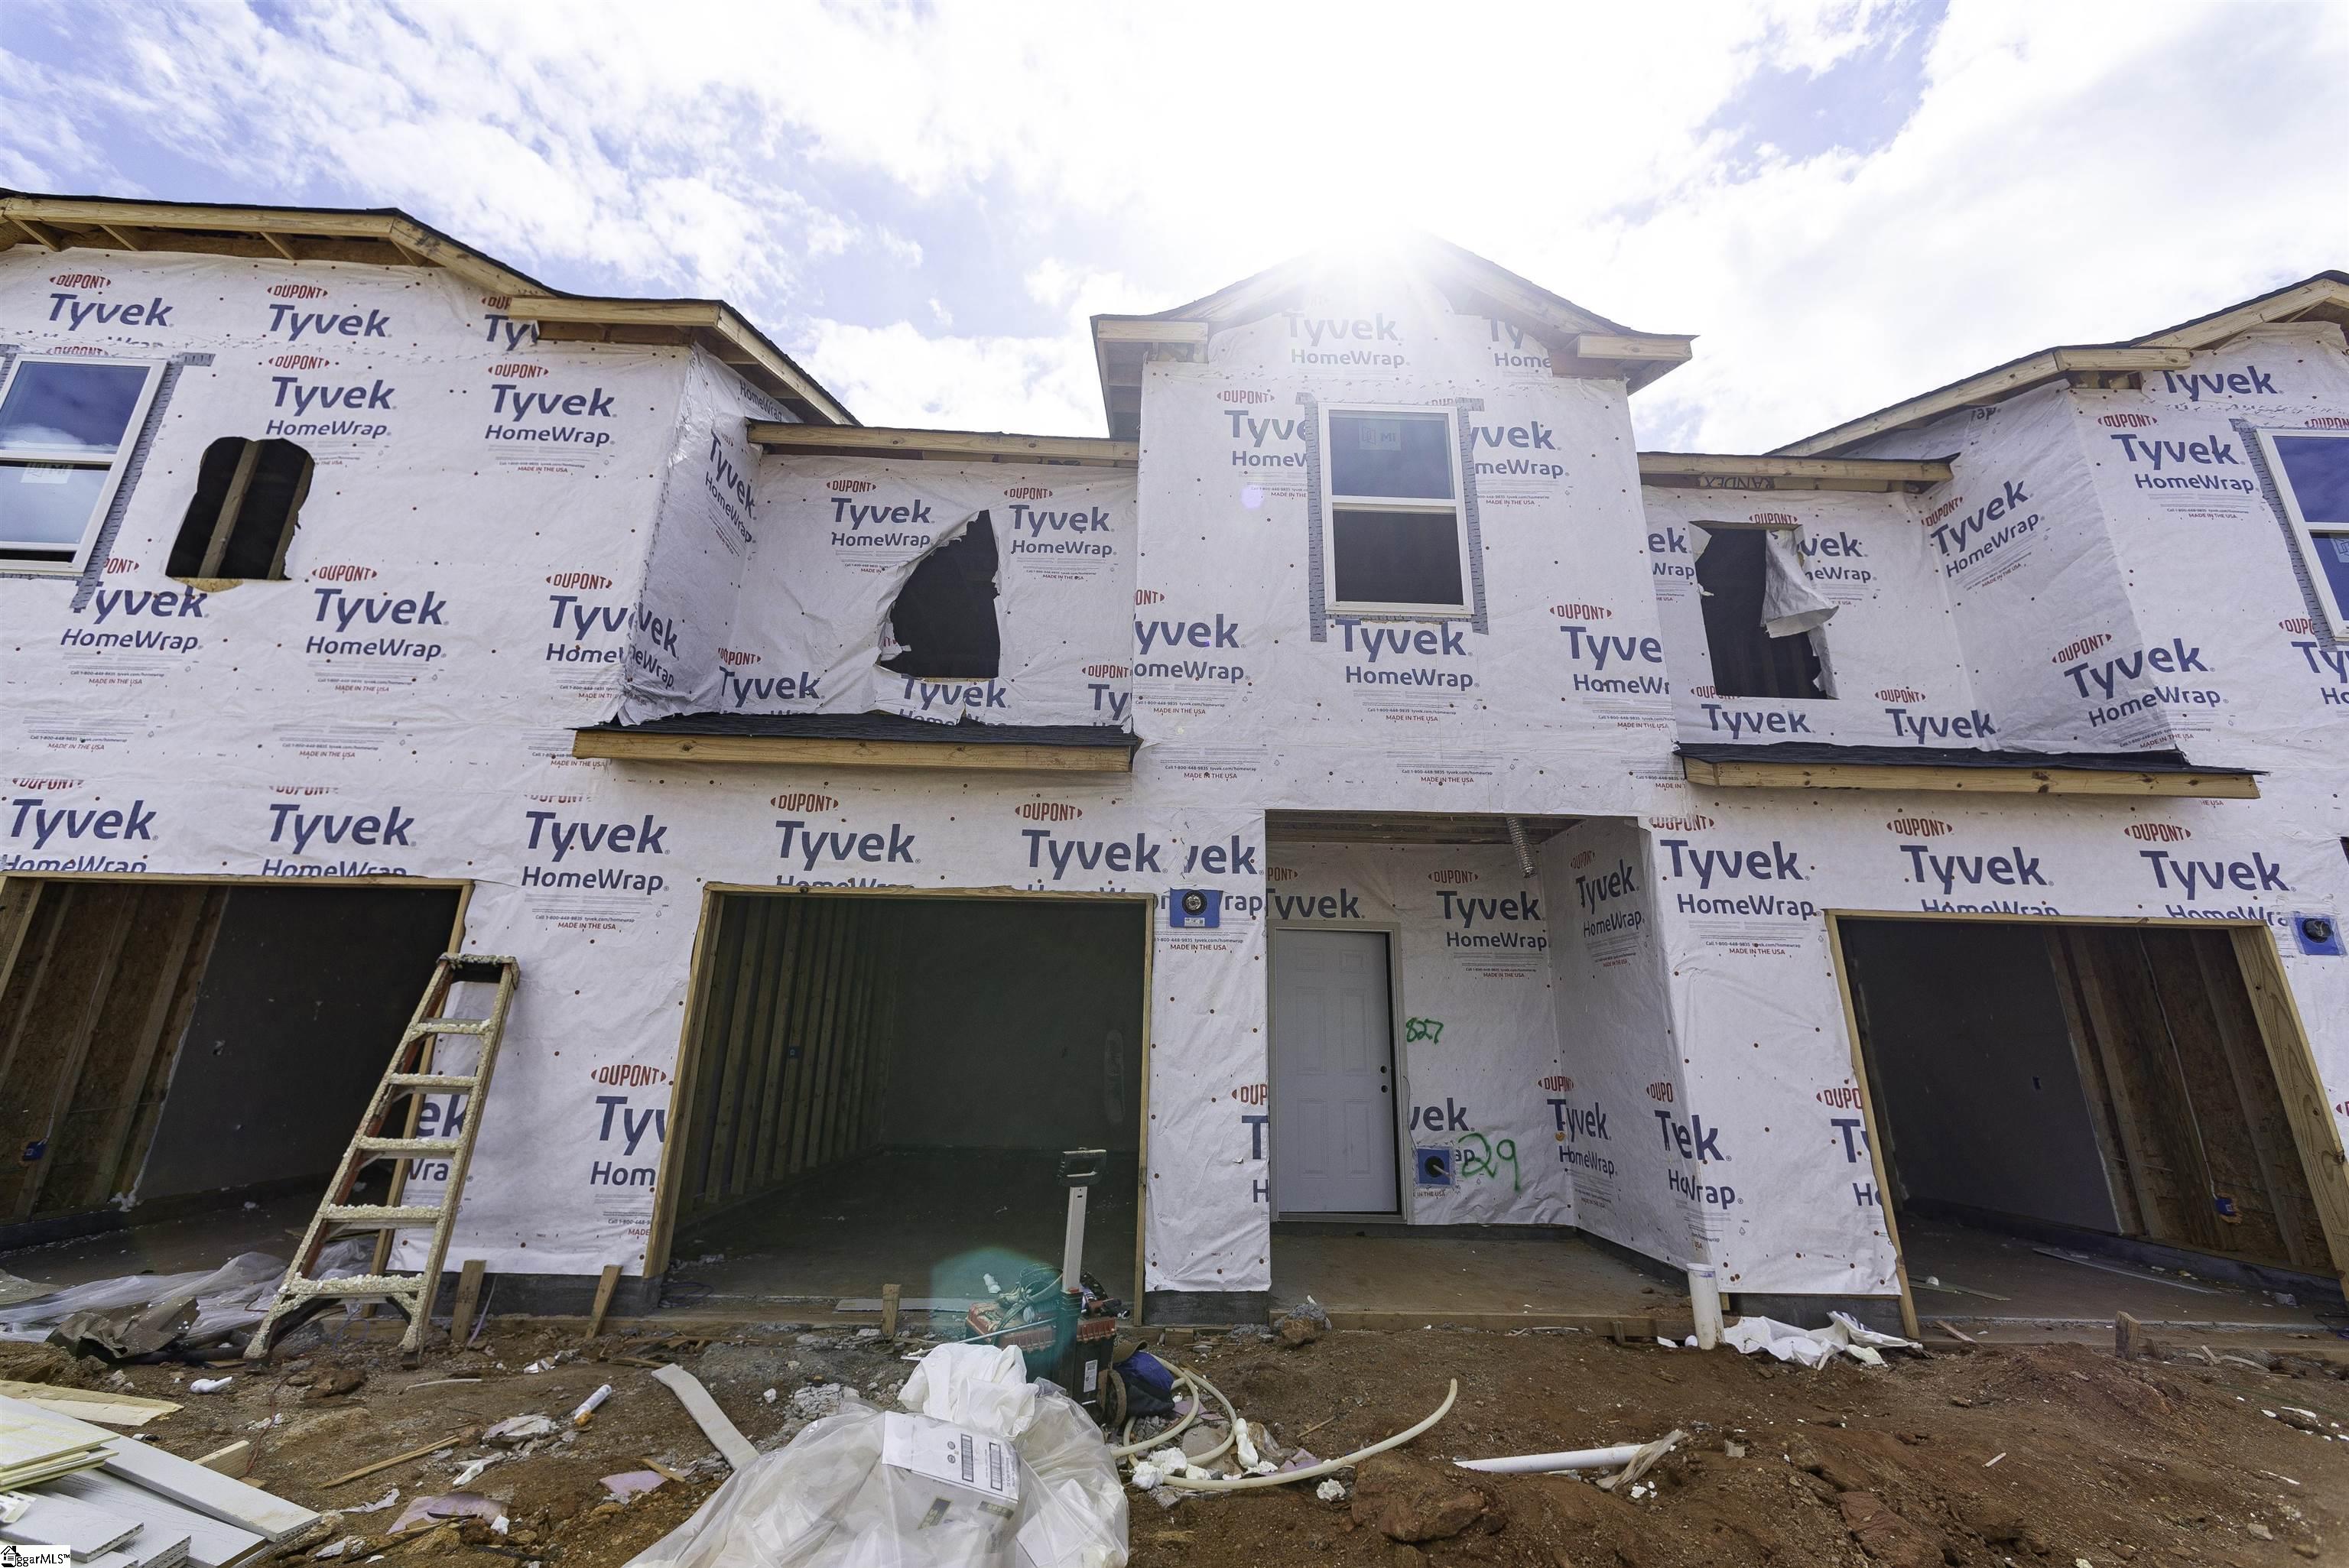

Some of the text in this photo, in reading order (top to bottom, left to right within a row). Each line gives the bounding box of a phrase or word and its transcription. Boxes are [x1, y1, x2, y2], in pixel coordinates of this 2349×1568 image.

[57, 274, 105, 289] DUPONT
[274, 285, 322, 299] DUPONT
[49, 293, 174, 331] Tyvek
[270, 304, 389, 342] Tyvek
[1282, 312, 1399, 347] Tyvek
[275, 355, 322, 369] DUPONT
[495, 364, 543, 378] DUPONT
[1291, 349, 1405, 368] HomeWrap
[272, 376, 393, 417] Tyvek
[1223, 390, 1269, 404] DUPONT
[2153, 365, 2278, 402] Tyvek
[491, 384, 615, 422] Tyvek
[266, 420, 387, 440] HomeWrap
[485, 425, 610, 447] HomeWrap
[2104, 414, 2152, 428] DUPONT
[2110, 433, 2240, 470] Tyvek
[710, 428, 755, 519] Tyvek
[832, 479, 872, 493] DUPONT
[2134, 473, 2254, 495] HomeWrap
[705, 471, 752, 544] HomeWrap
[1010, 488, 1048, 500] DUPONT
[830, 497, 931, 530] Tyvek
[1009, 504, 1111, 536] Tyvek
[1754, 513, 1792, 524] DUPONT
[1926, 497, 1959, 527] DUPONT
[1930, 480, 2029, 555] Tyvek
[831, 531, 931, 548] HomeWrap
[1012, 540, 1113, 558] HomeWrap
[1946, 514, 2039, 578] HomeWrap
[319, 565, 370, 581] DUPONT
[554, 573, 606, 590] DUPONT
[314, 588, 447, 633] Tyvek
[1557, 604, 1605, 621] DUPONT
[60, 628, 198, 654] HomeWrap
[306, 635, 442, 661] HomeWrap
[1335, 618, 1467, 663] Tyvek
[2058, 634, 2105, 664] DUPONT
[1087, 664, 1129, 678] DUPONT
[1345, 665, 1473, 691] HomeWrap
[2064, 638, 2209, 700] Tyvek
[719, 665, 820, 708] Tyvek
[900, 674, 1007, 711] Tyvek
[1881, 689, 1920, 703] DUPONT
[1701, 703, 1811, 739] Tyvek
[2087, 686, 2221, 728] HomeWrap
[1885, 708, 1997, 745] Tyvek
[778, 792, 833, 813] DUPONT
[1022, 802, 1077, 822] DUPONT
[11, 799, 157, 850] Tyvek
[269, 803, 415, 855] Tyvek
[525, 810, 668, 862] Tyvek
[1894, 819, 1946, 837] DUPONT
[2131, 823, 2183, 842] DUPONT
[775, 820, 917, 872] Tyvek
[1022, 829, 1162, 881] Tyvek
[1573, 850, 1592, 869] DUPONT
[1433, 869, 1474, 884] DUPONT
[1660, 839, 1805, 889] Tyvek
[1900, 845, 2048, 895] Tyvek
[2139, 849, 2290, 901] Tyvek
[521, 866, 664, 896] HomeWrap
[1575, 859, 1636, 915] Tyvek
[1436, 891, 1542, 928] Tyvek
[1677, 893, 1814, 920] HomeWrap
[1584, 911, 1642, 938] HomeWrap
[1446, 931, 1548, 952] HomeWrap
[1405, 1017, 1444, 1044] 827
[598, 1064, 660, 1087] DUPONT
[1547, 1099, 1609, 1143] Tyvek
[1559, 1145, 1615, 1179] HomeWrap
